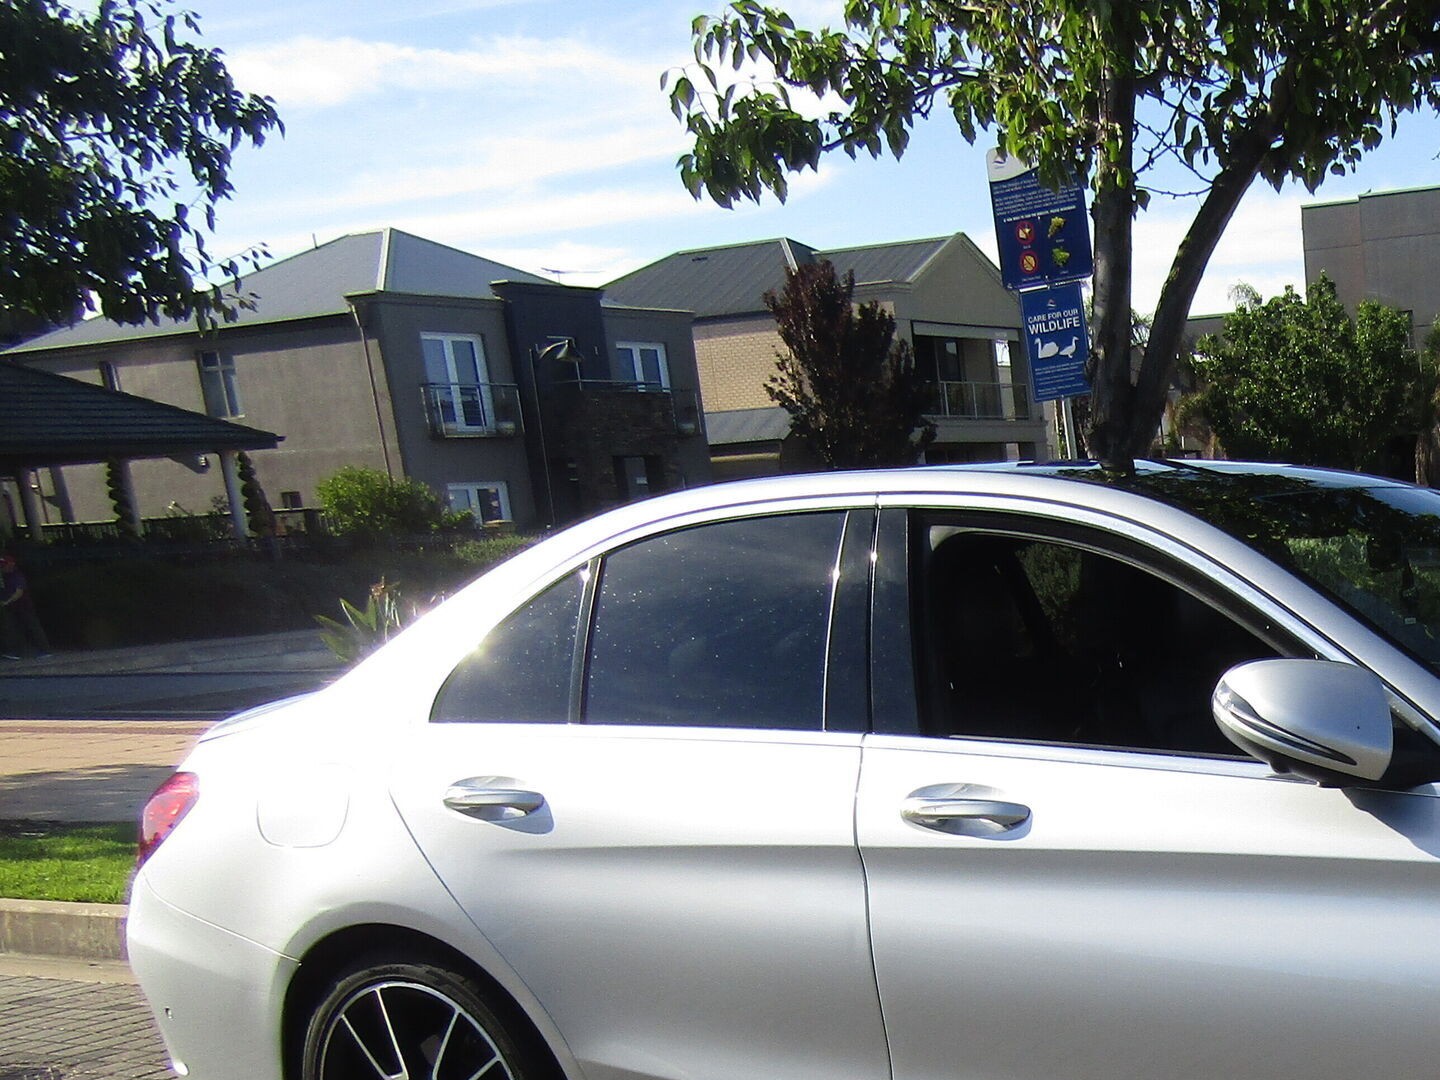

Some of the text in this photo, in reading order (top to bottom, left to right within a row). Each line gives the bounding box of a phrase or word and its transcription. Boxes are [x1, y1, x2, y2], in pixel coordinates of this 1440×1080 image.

[1027, 314, 1047, 324] CARE
[1047, 311, 1062, 320] FOR
[1062, 308, 1079, 317] OUR
[1027, 316, 1081, 335] WILDLIFE
